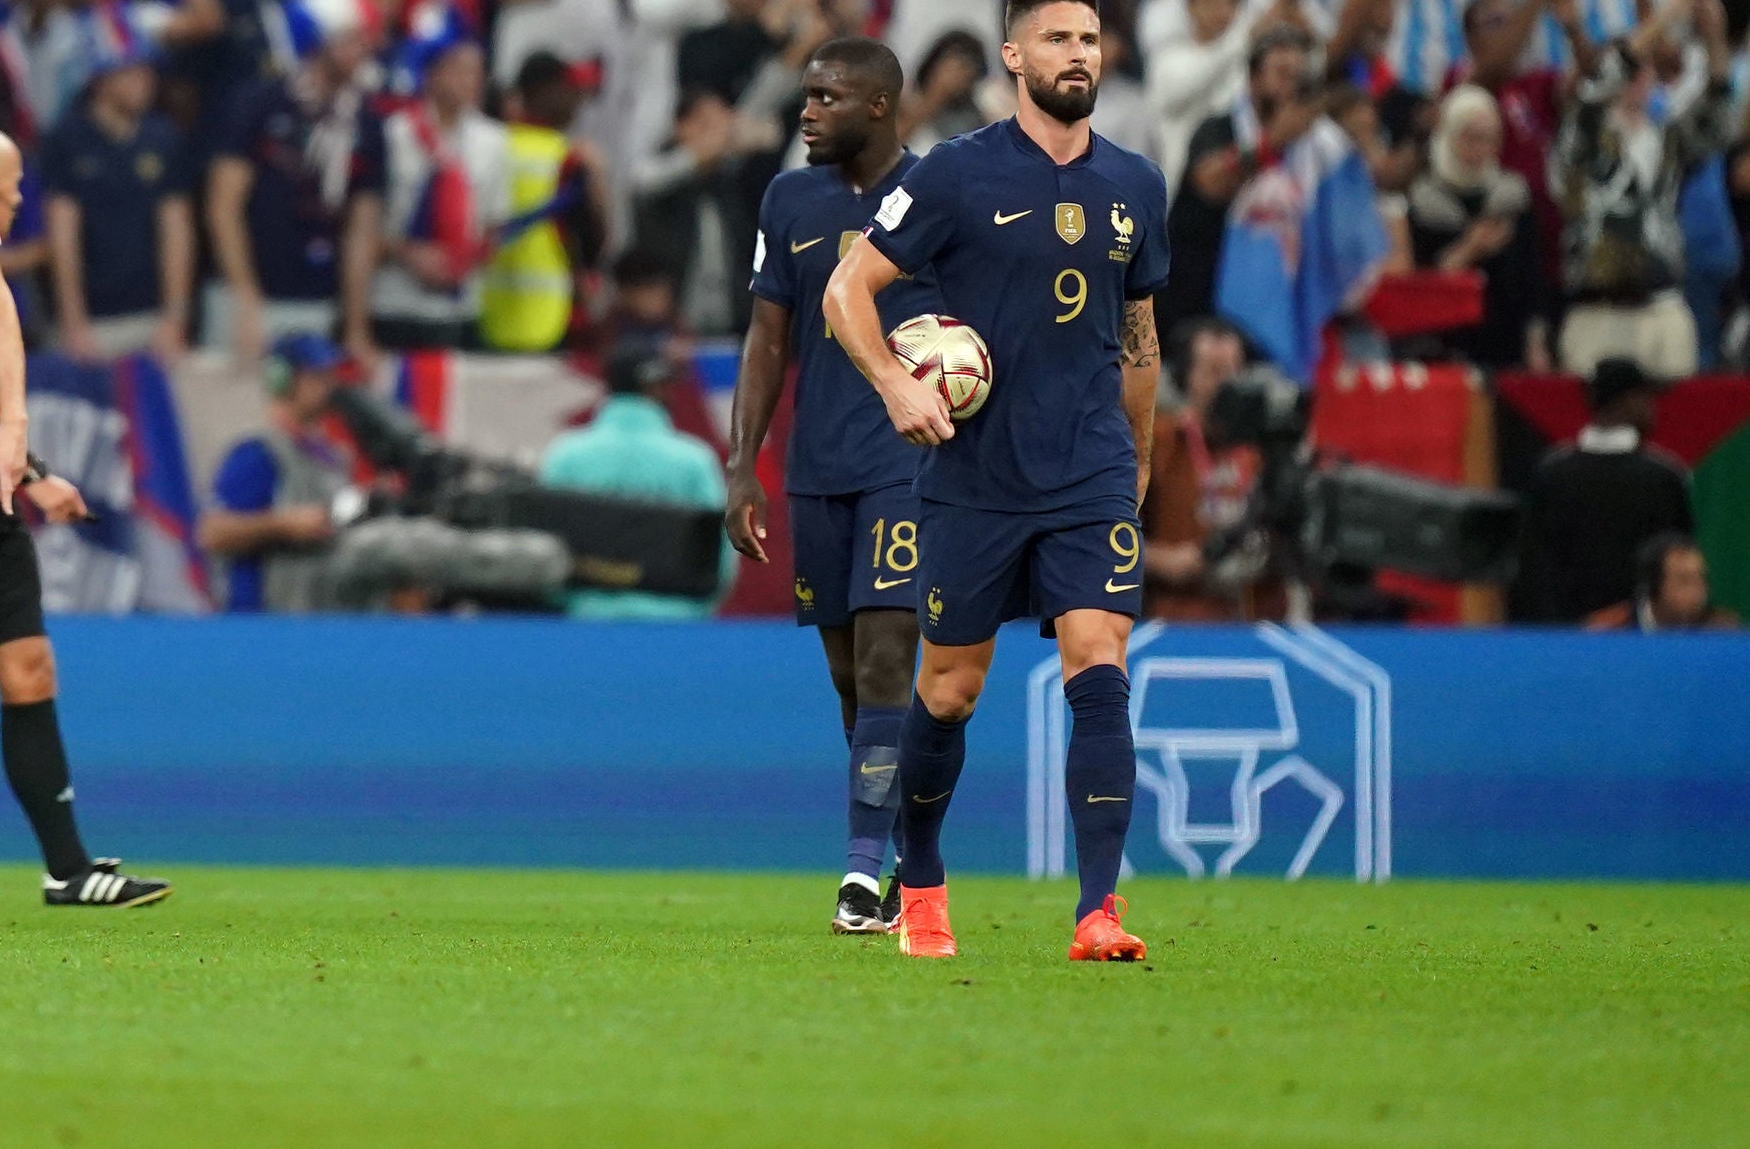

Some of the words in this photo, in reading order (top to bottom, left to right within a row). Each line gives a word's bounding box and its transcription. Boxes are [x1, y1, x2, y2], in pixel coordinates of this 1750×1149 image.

[1054, 268, 1088, 323] 9
[871, 518, 919, 572] 18
[1109, 522, 1140, 573] 9
